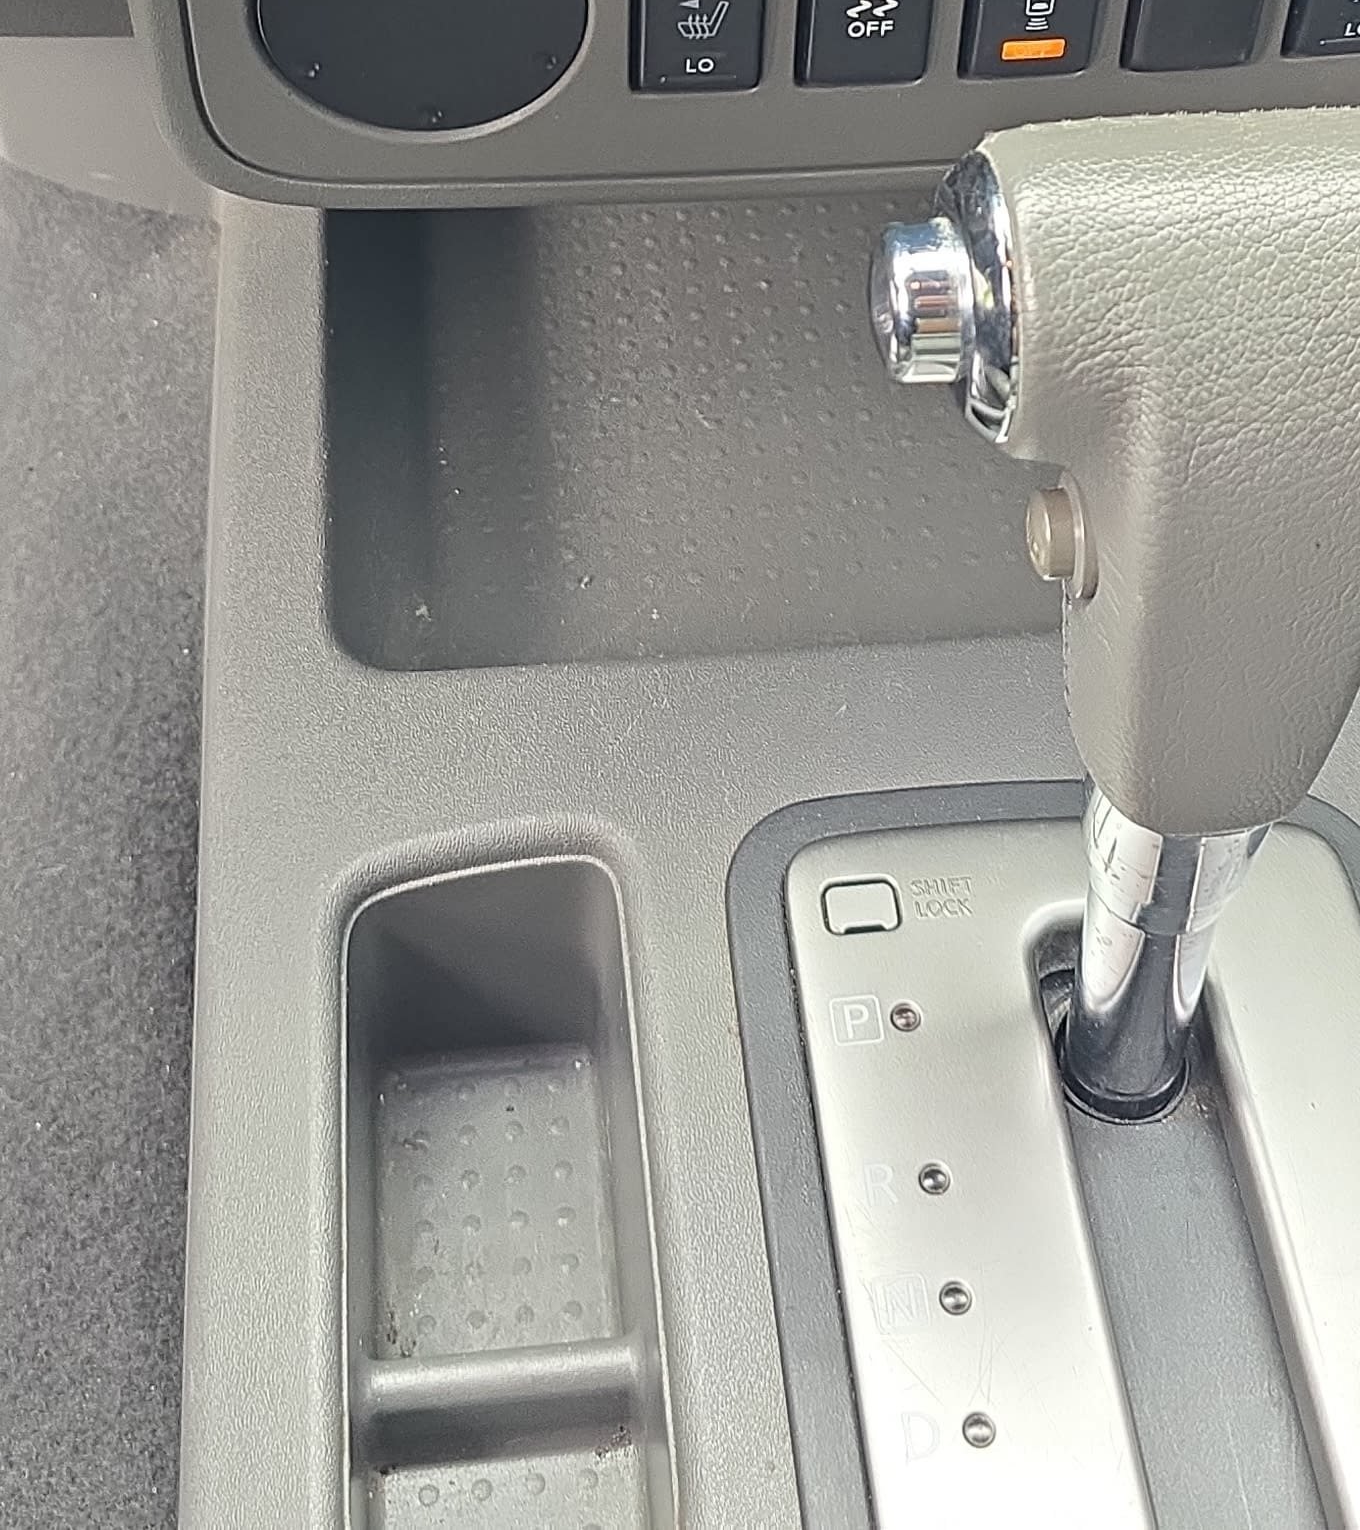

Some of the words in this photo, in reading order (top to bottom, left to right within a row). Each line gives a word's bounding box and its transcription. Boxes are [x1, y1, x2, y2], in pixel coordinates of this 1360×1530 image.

[846, 20, 895, 40] OFF
[684, 57, 715, 76] LO
[910, 876, 974, 897] SHIFT
[913, 899, 974, 919] LOCK
[841, 1003, 870, 1038] P
